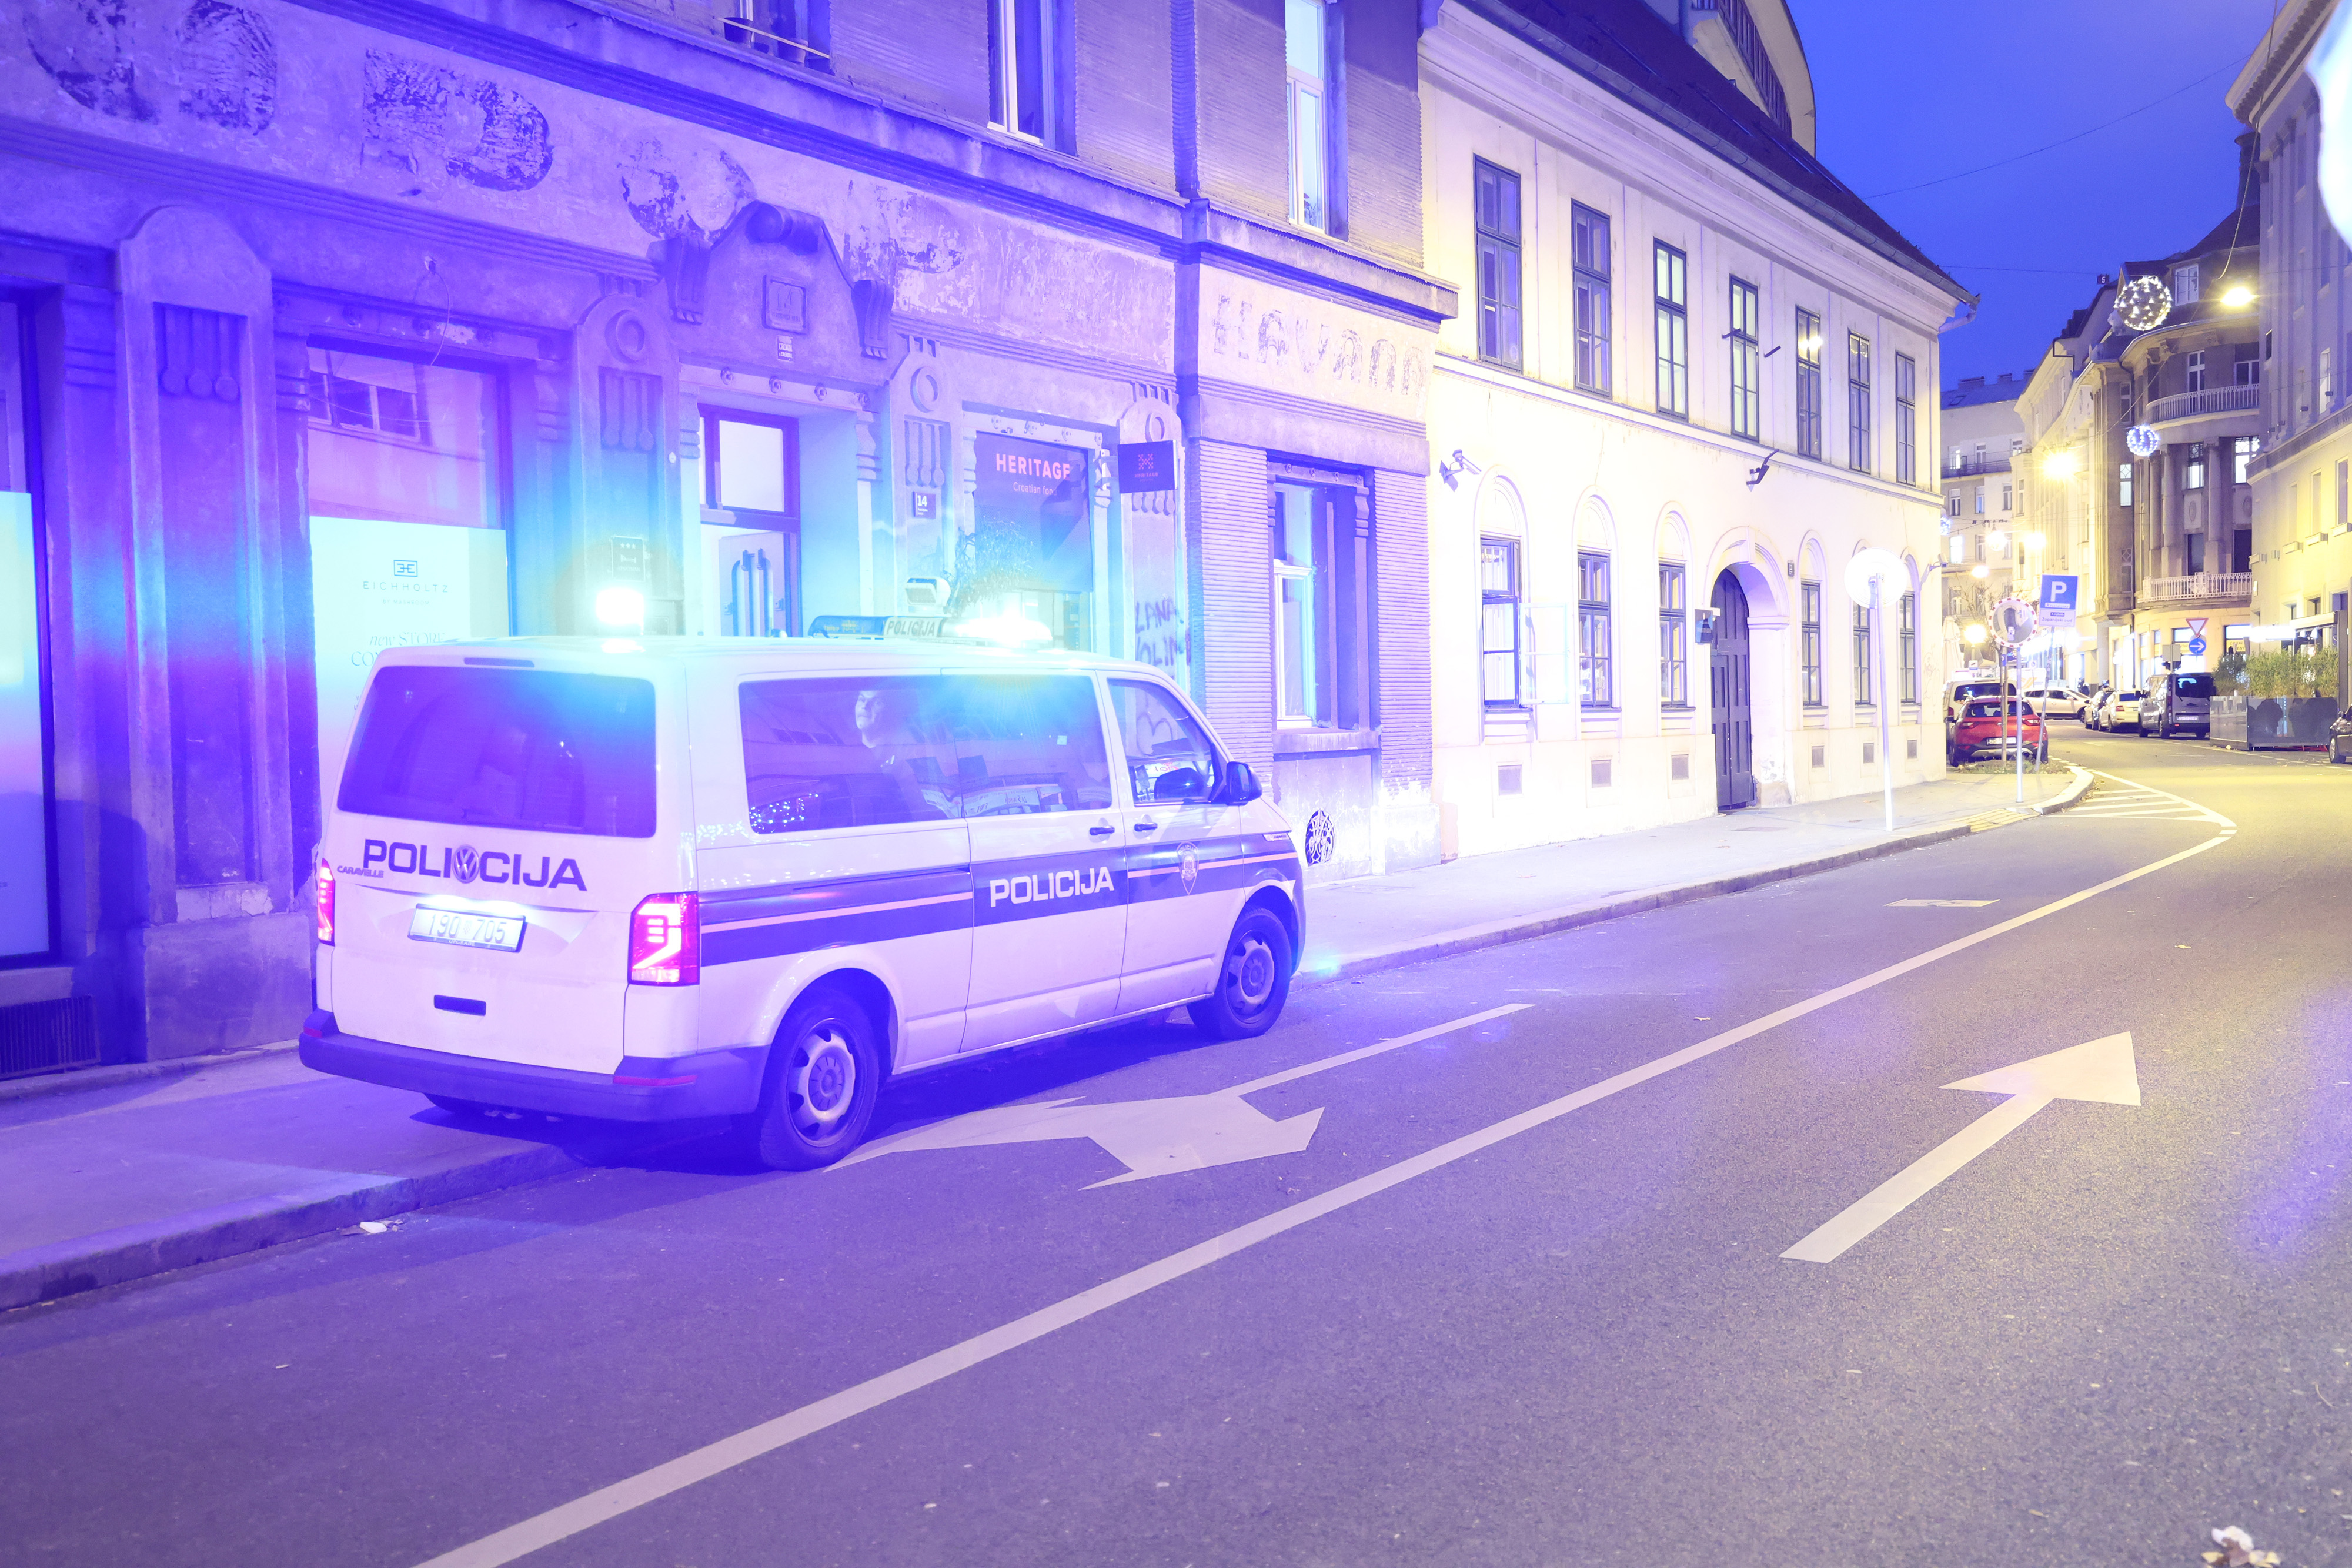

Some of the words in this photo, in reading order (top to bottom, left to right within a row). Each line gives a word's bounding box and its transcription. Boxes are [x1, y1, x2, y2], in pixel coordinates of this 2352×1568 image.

[996, 453, 1070, 480] HERITAGE
[1013, 482, 1041, 494] Croatian
[917, 494, 928, 507] 14
[363, 581, 447, 593] EICHHOLTZ
[2050, 581, 2067, 602] P
[886, 618, 936, 637] POLICIJA
[370, 636, 395, 646] new
[337, 865, 384, 878] CARAVELLE
[990, 866, 1114, 908] POLICIJA
[429, 913, 461, 938] 190
[473, 918, 507, 944] 705
[449, 939, 476, 947] UPGRADE
